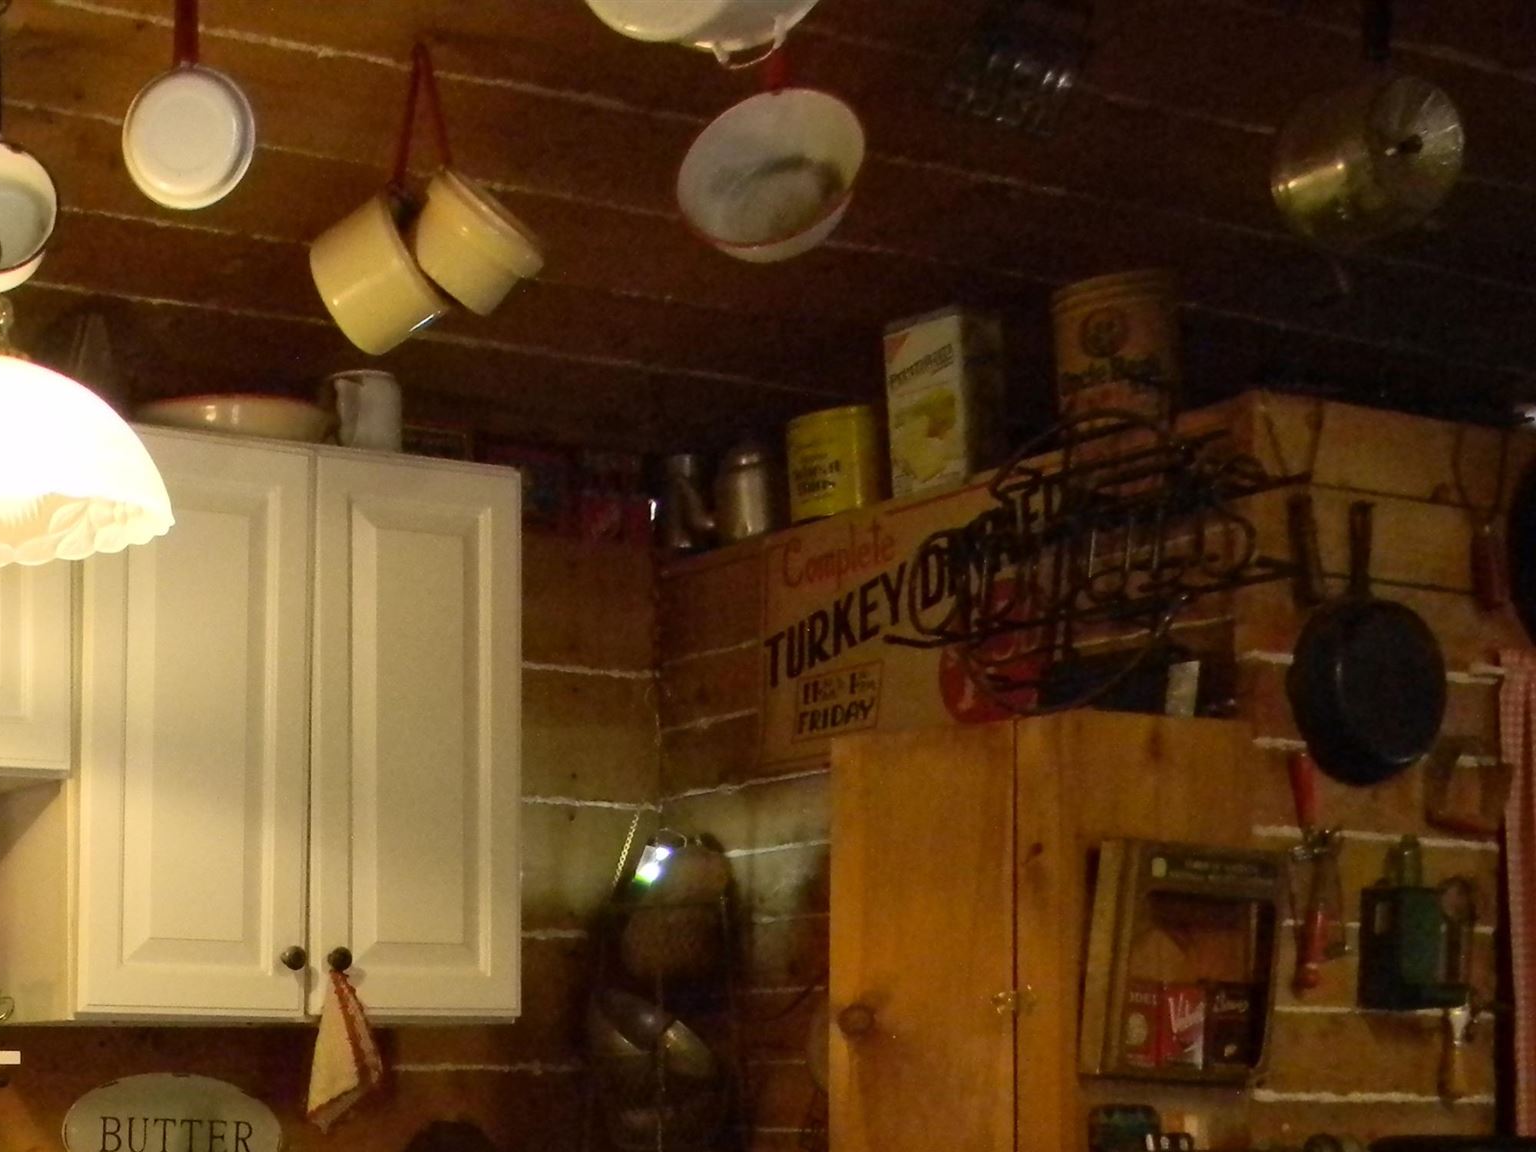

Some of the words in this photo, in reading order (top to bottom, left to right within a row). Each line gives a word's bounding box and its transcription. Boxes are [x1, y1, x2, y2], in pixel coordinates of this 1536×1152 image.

[782, 516, 896, 591] Complete
[764, 560, 907, 688] TURKEY
[797, 695, 875, 735] FRIDAY
